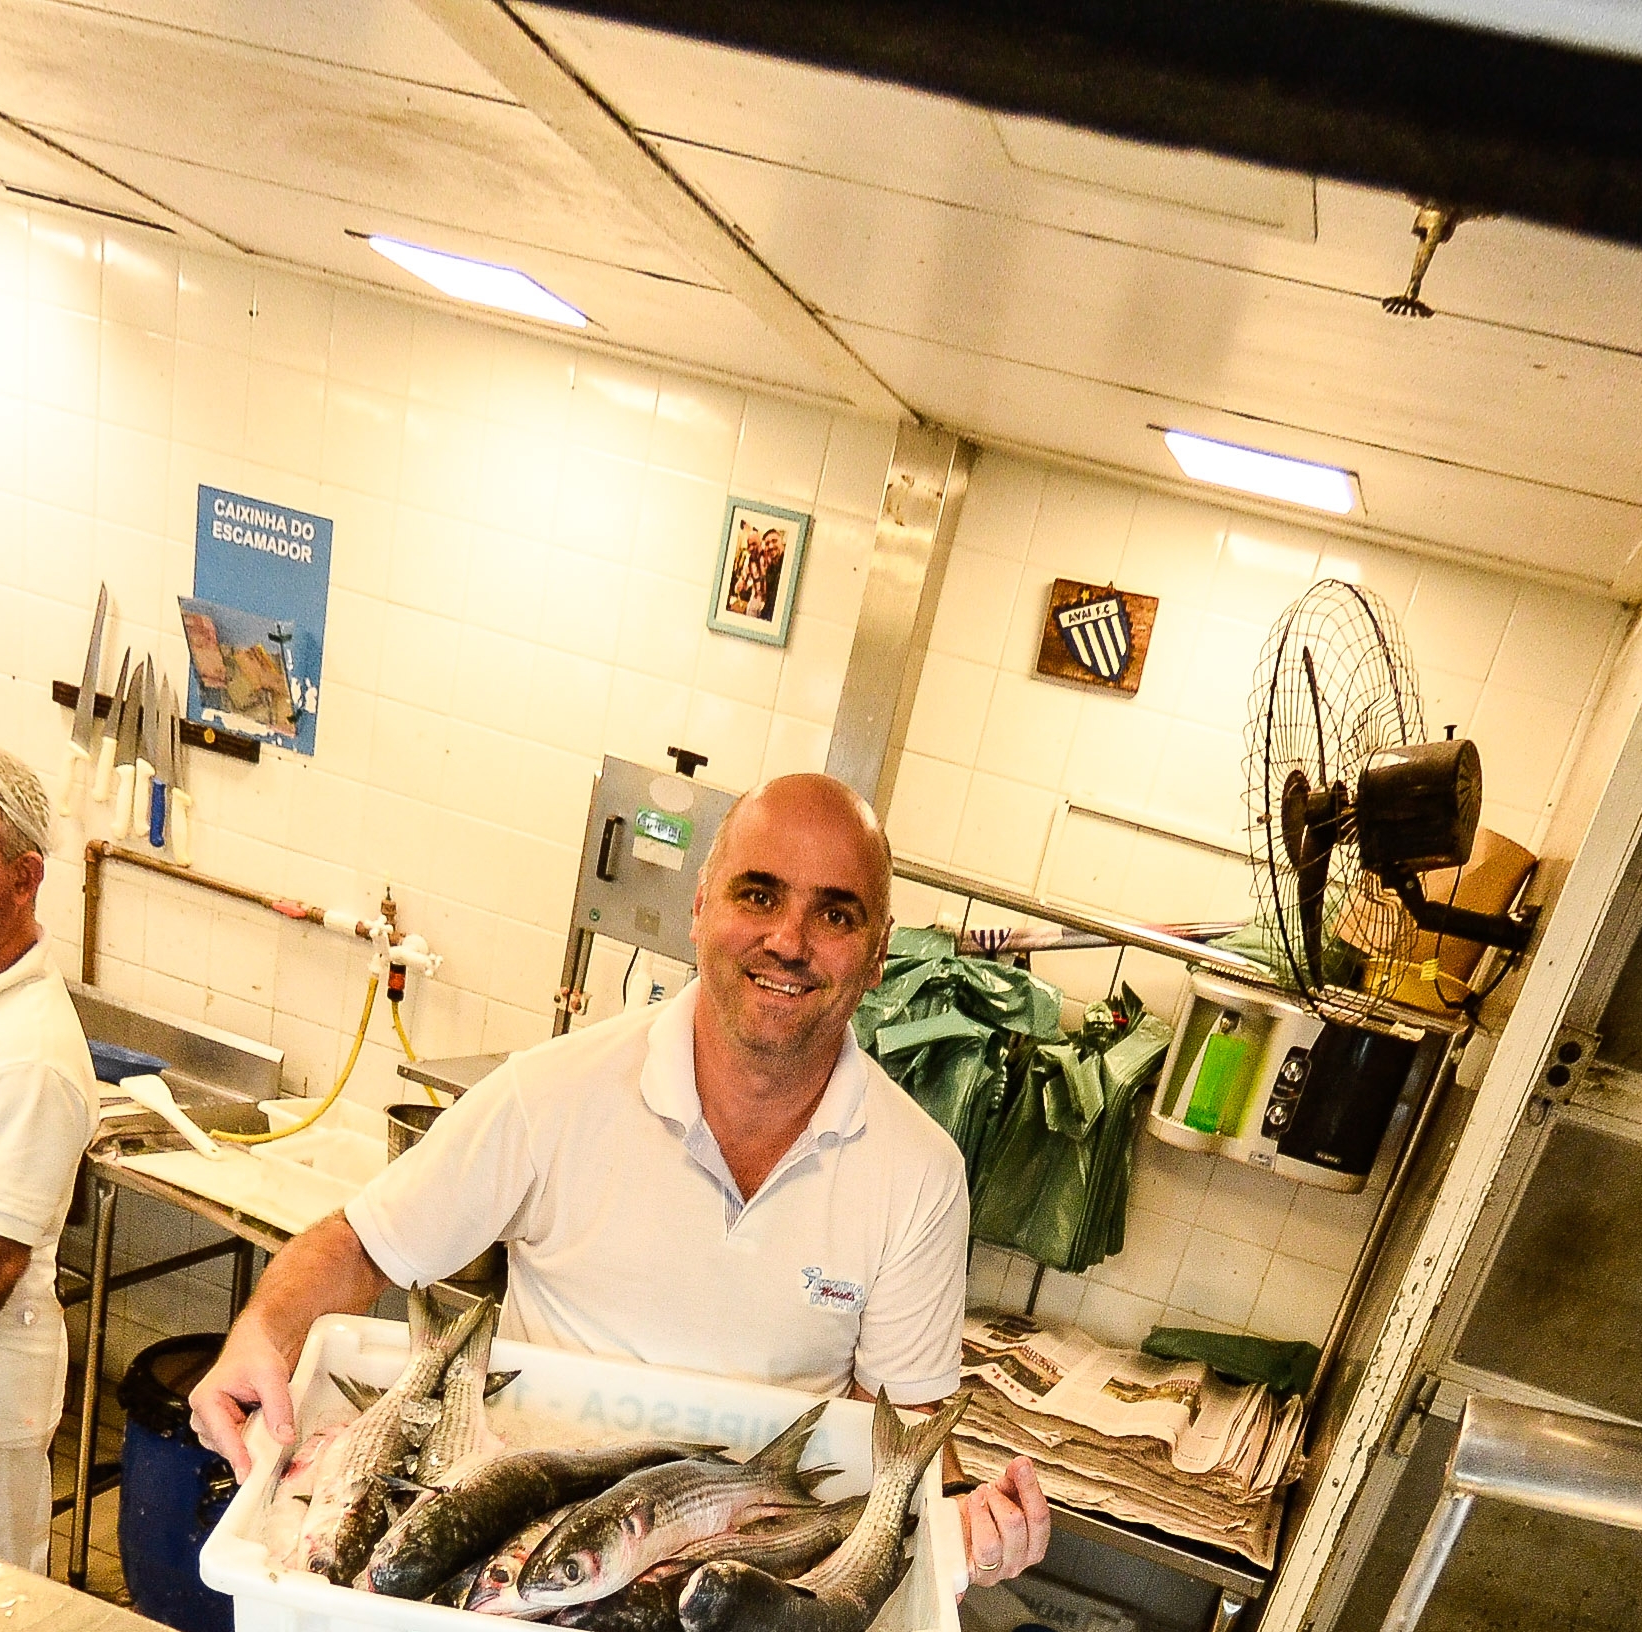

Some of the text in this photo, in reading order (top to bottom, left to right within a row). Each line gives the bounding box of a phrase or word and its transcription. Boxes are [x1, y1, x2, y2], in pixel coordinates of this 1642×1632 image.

[214, 499, 315, 541] CAIXINHA DO
[212, 520, 313, 563] ESCAMADOR
